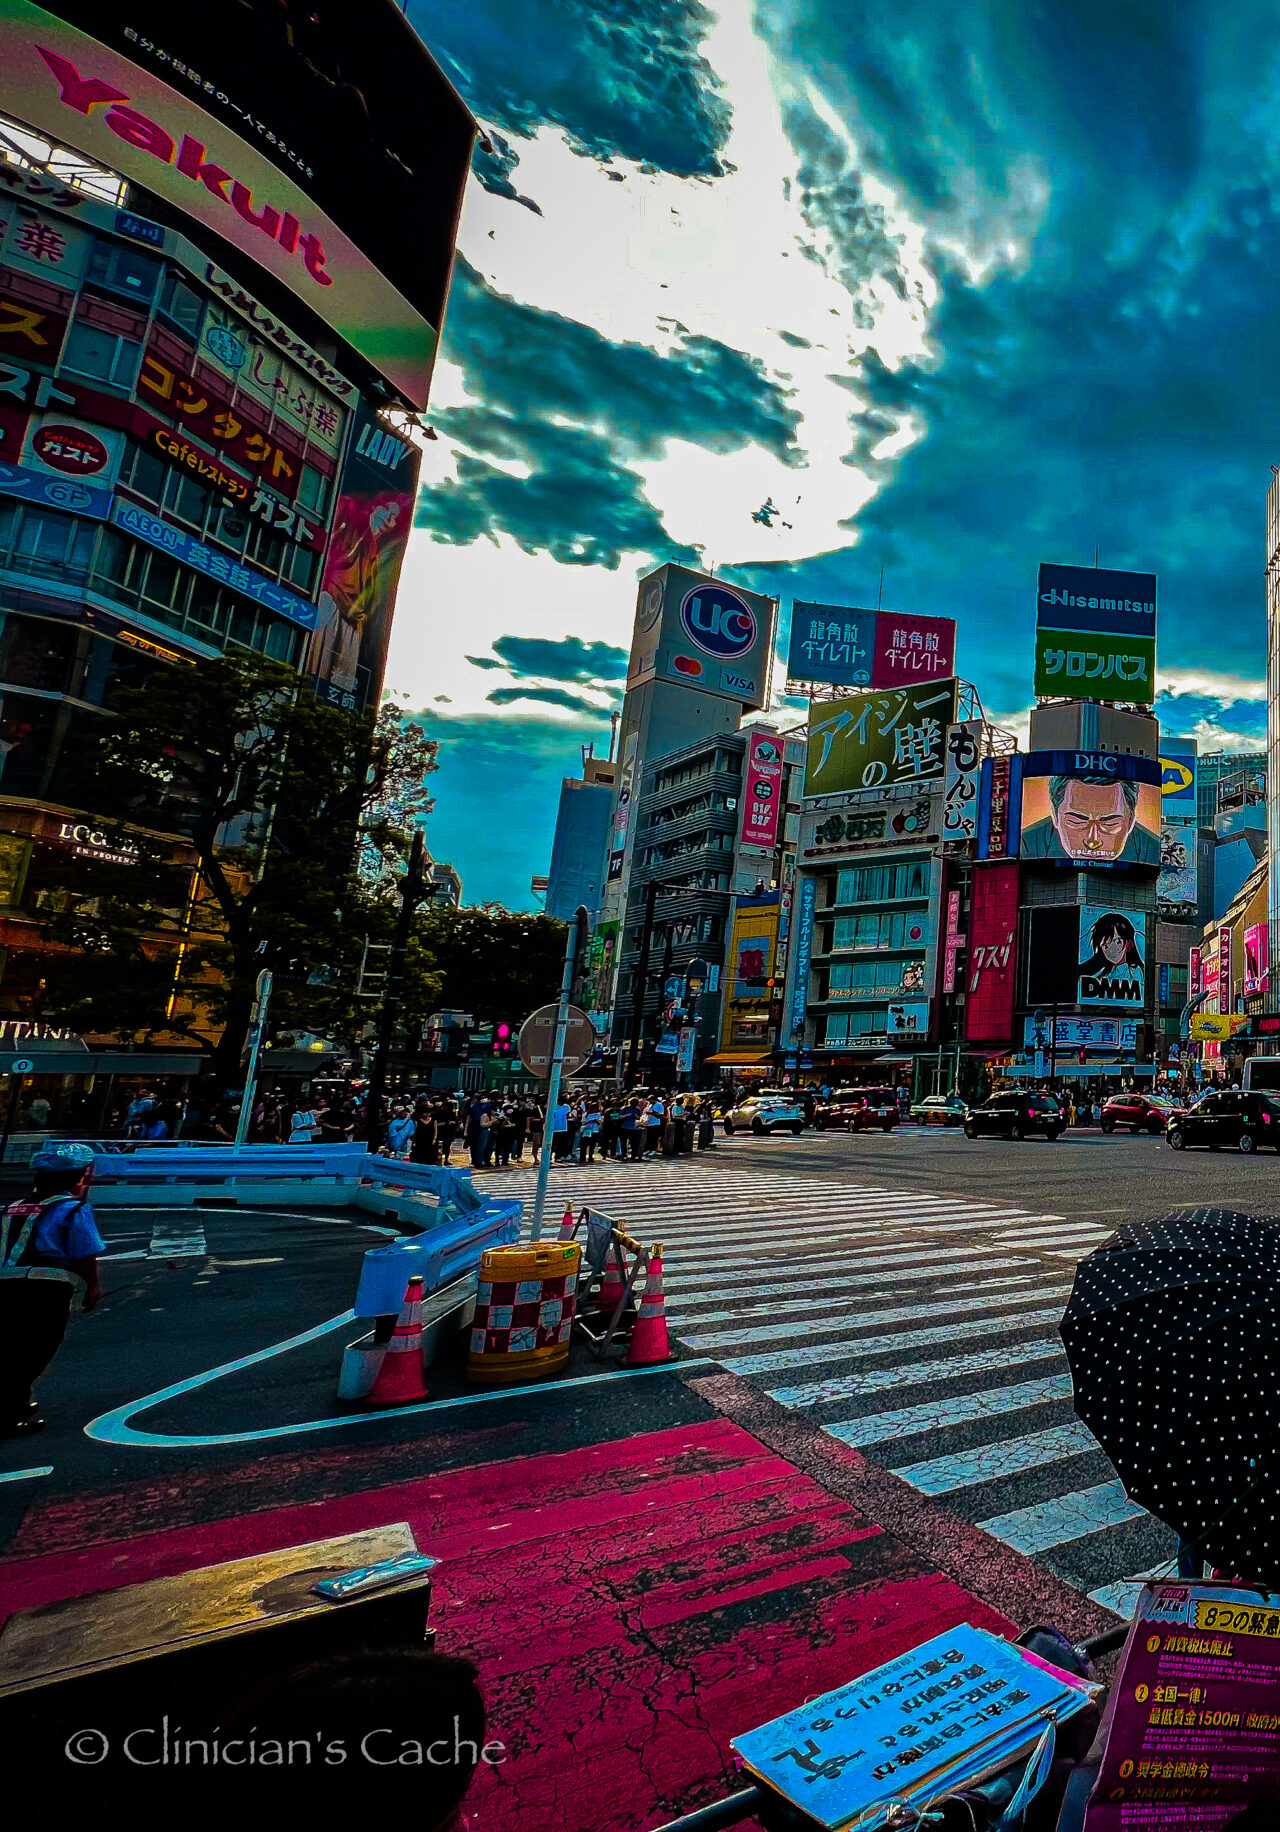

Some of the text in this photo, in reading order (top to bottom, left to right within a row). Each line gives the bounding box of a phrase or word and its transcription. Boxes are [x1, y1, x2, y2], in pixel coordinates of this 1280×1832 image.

[35, 43, 334, 286] Yakult
[141, 356, 294, 477] コンタクト
[253, 351, 337, 437] しゃぶ葉
[42, 441, 100, 464] ガスト
[156, 431, 248, 499] Caféレストラン
[355, 422, 416, 470] LADY
[51, 486, 87, 503] 6F
[250, 489, 314, 542] ガスト
[124, 508, 177, 547] AEON
[188, 541, 250, 590] 英会話
[251, 581, 314, 621] イーオン
[691, 597, 750, 643] UC
[1040, 588, 1154, 614] Hisamitsu
[801, 640, 867, 664] ダイレクト
[809, 619, 859, 644] 龍角散
[892, 628, 940, 652] 龍角散
[725, 672, 755, 693] VISA
[885, 648, 948, 672] ダイレクト
[1043, 648, 1149, 682] サロンパス
[809, 690, 951, 778] アイジー
[861, 717, 945, 787] の壁
[944, 724, 979, 837] もんじゃ
[1075, 753, 1117, 773] DHC
[612, 858, 622, 870] 7F
[799, 893, 812, 976] サマーフルーツギフト
[1219, 933, 1230, 978] カラオケ
[969, 931, 1014, 993] クスリ
[1081, 977, 1142, 1001] DMM
[1162, 1635, 1235, 1657] 消費税は廃止
[797, 1648, 966, 1733] 合憲になりうる。
[898, 1662, 987, 1714] 徴兵制が
[871, 1690, 1031, 1781] 憲法に自衛隊が
[876, 1678, 1009, 1749] 明記されると
